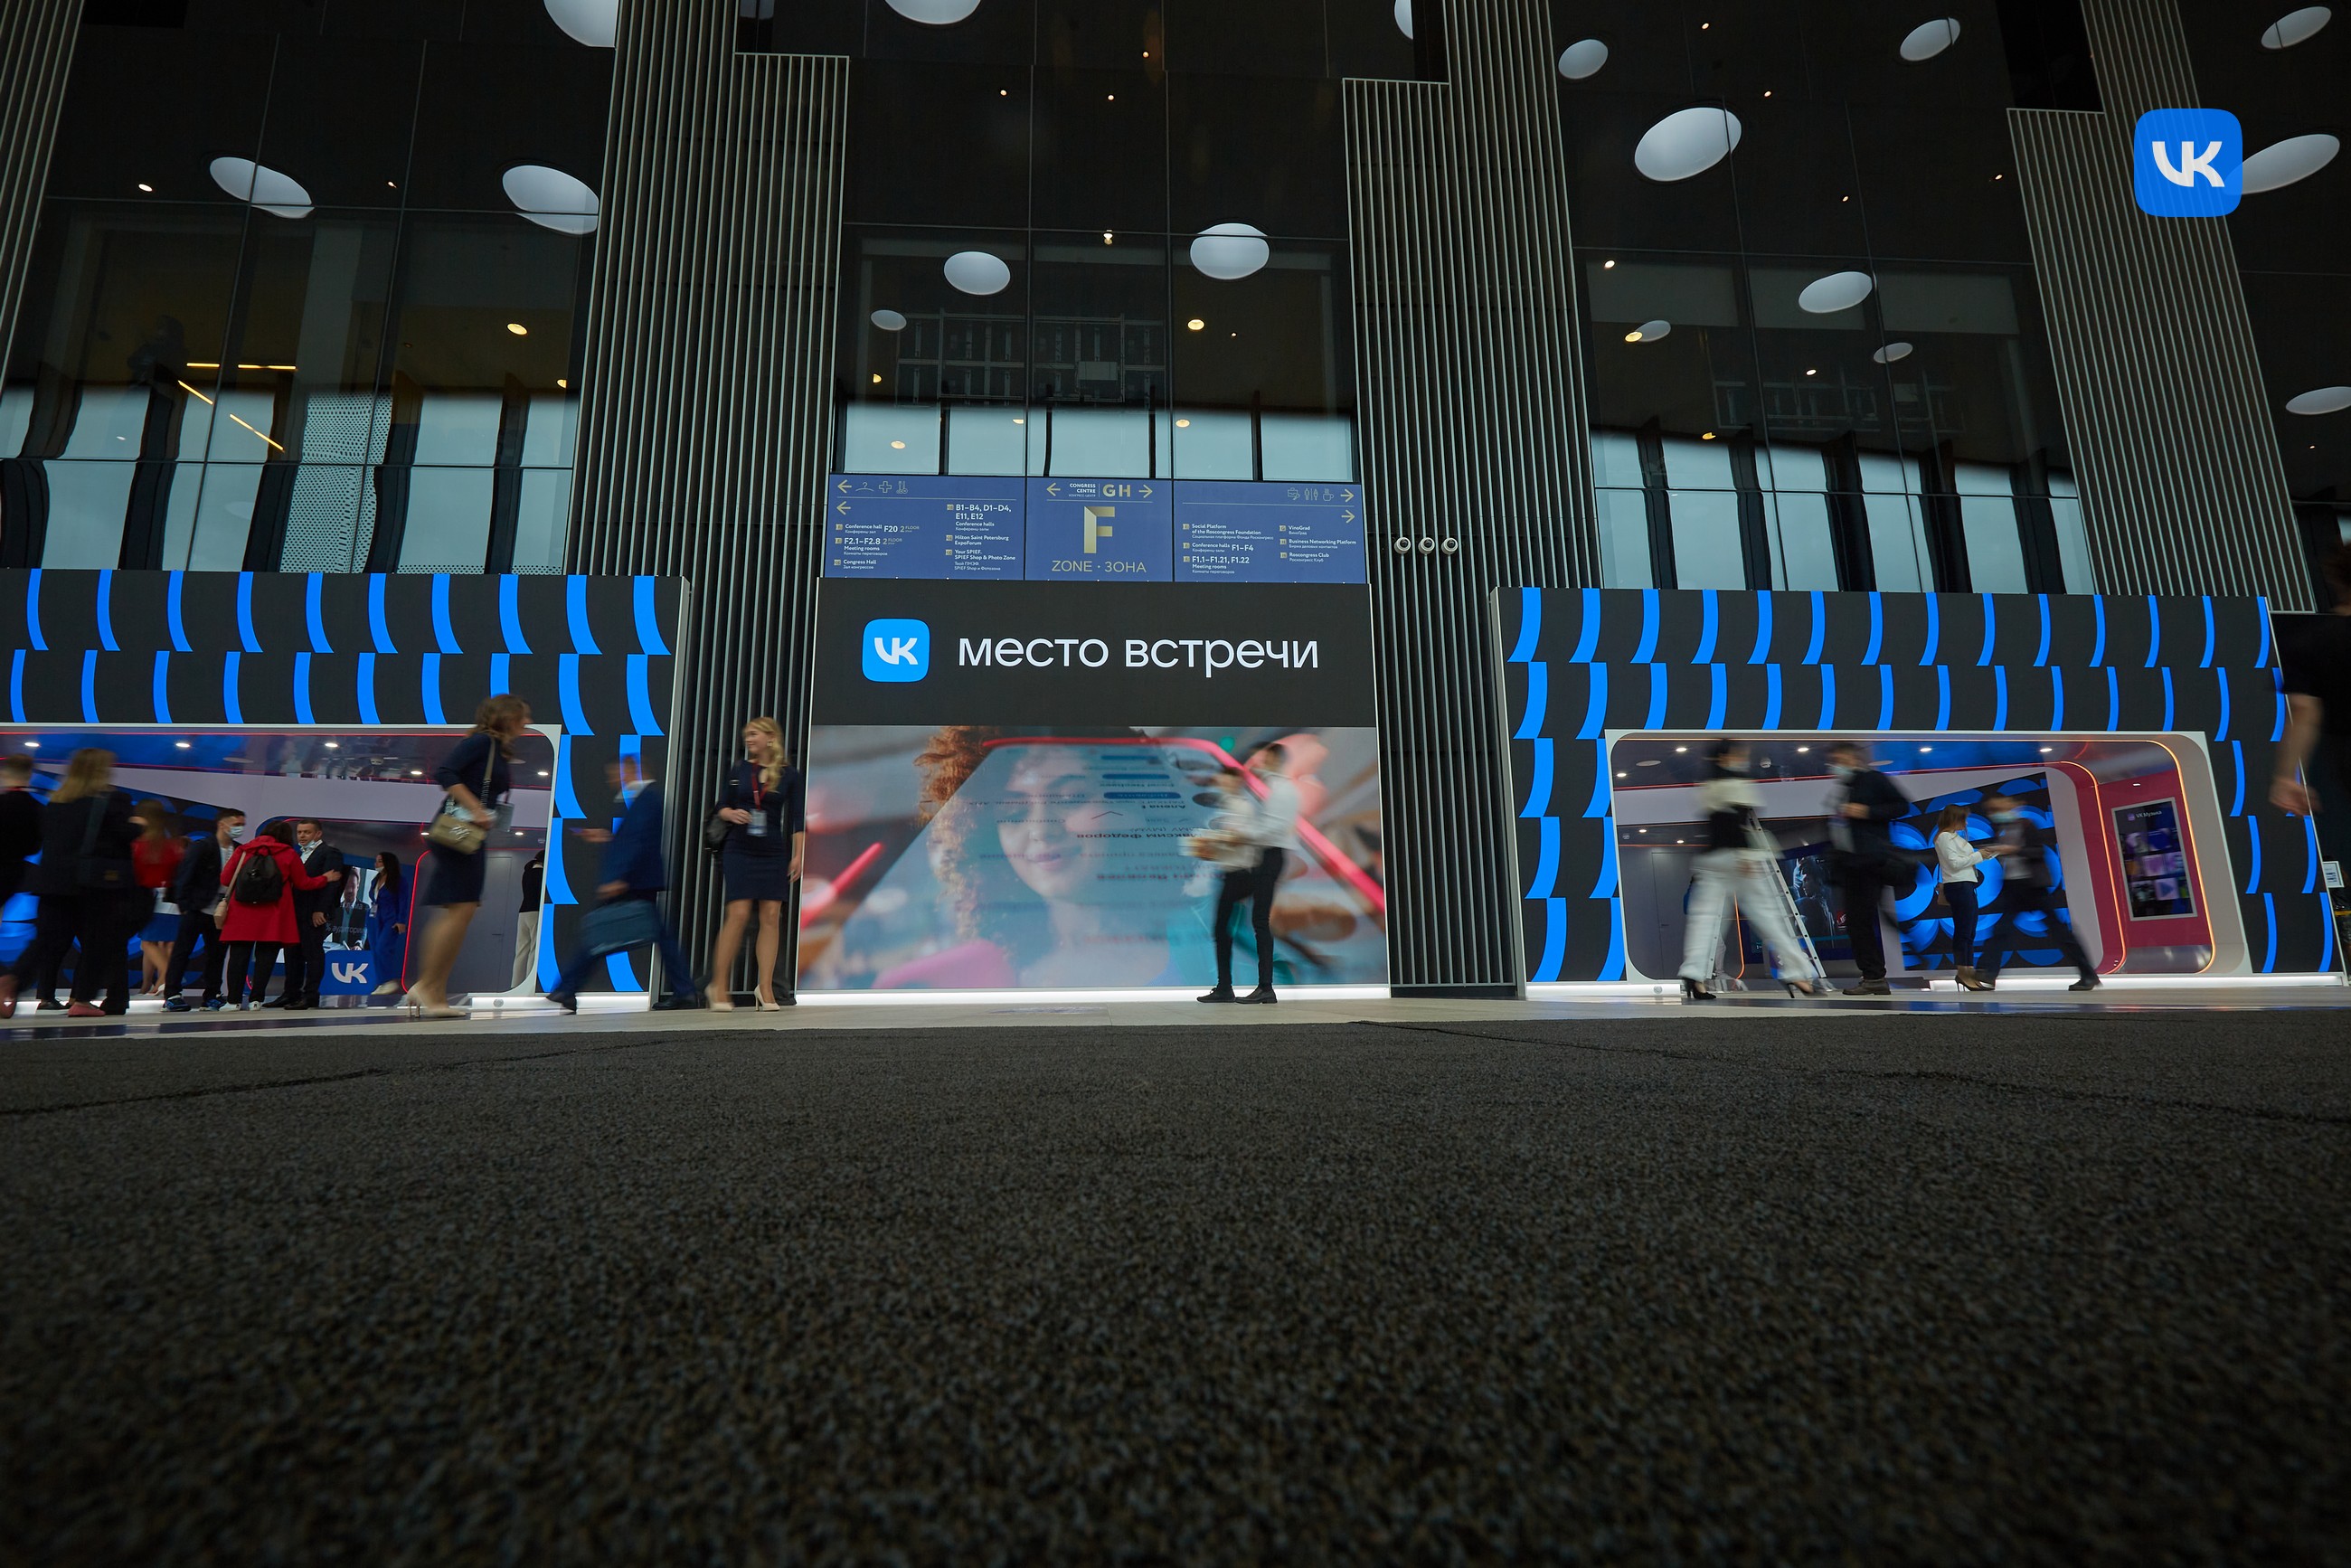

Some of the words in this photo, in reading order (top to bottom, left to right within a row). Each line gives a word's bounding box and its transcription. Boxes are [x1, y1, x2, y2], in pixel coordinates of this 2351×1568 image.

[1084, 506, 1115, 554] F
[1052, 560, 1092, 572] ZONE
[1105, 561, 1146, 573] ЗОНА
[873, 637, 919, 666] VK
[958, 638, 1109, 667] место
[1125, 638, 1318, 678] встречи
[331, 963, 369, 983] VK
